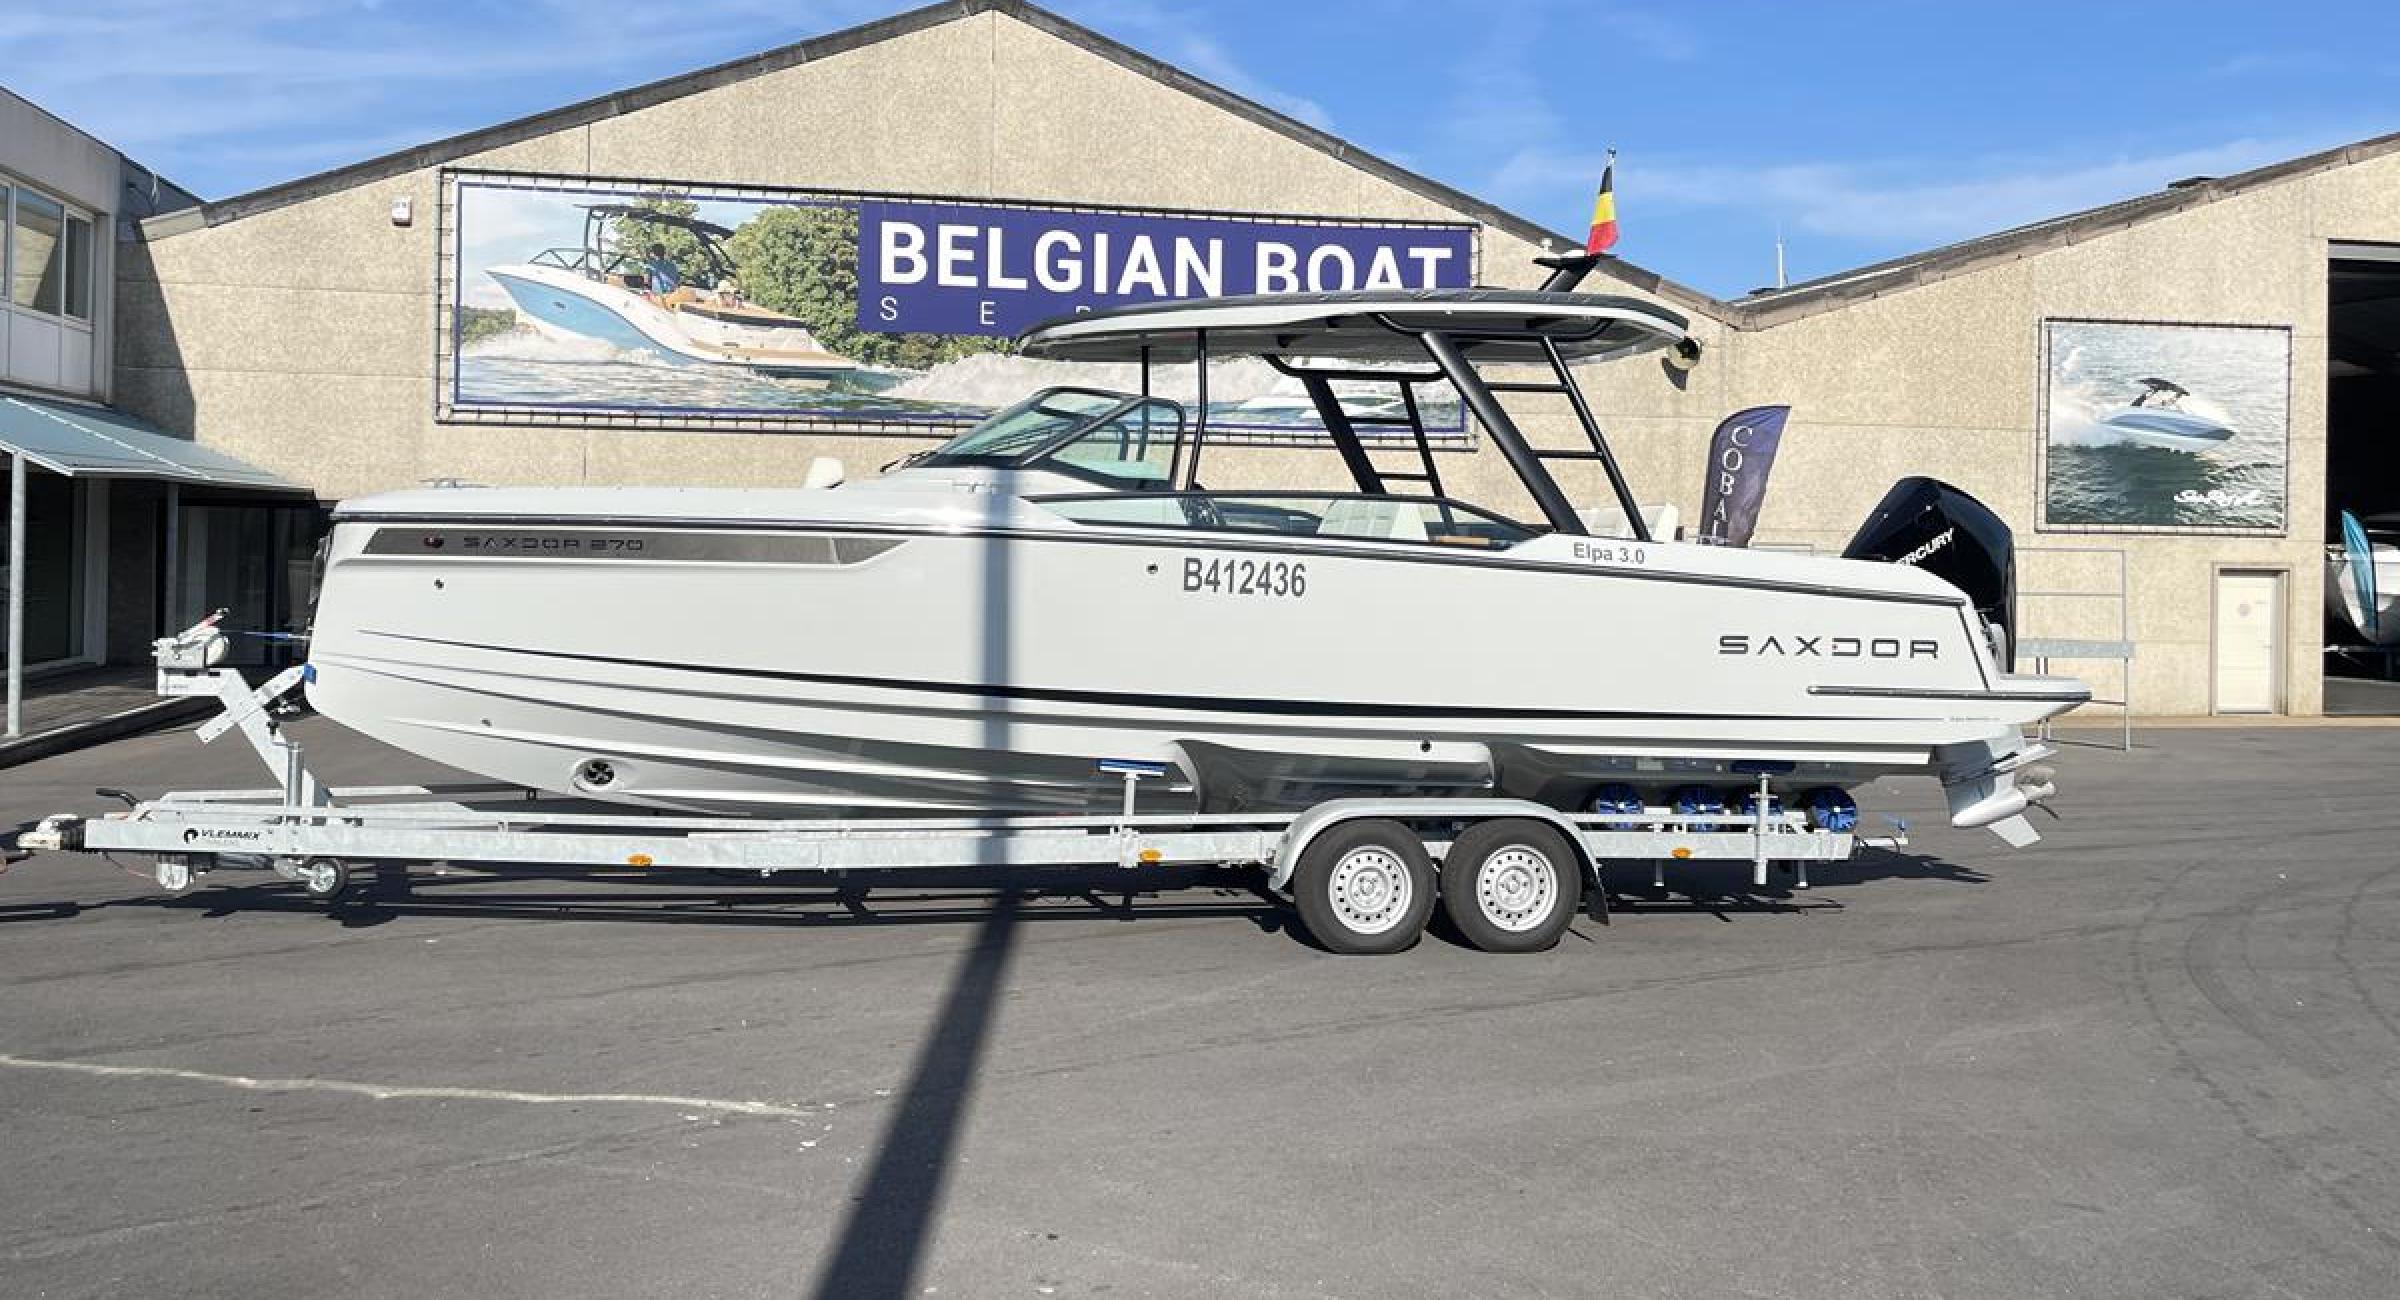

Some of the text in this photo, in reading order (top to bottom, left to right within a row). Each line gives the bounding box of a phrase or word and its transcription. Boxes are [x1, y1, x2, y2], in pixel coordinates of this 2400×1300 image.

[879, 221, 1453, 298] BELGIAN BOAT
[1711, 425, 1753, 541] COBAL
[463, 536, 644, 551] SAXDOR 270
[1573, 542, 1645, 564] Elpa 3.0
[1183, 557, 1307, 597] B412436
[1718, 635, 1939, 659] SAXDOR
